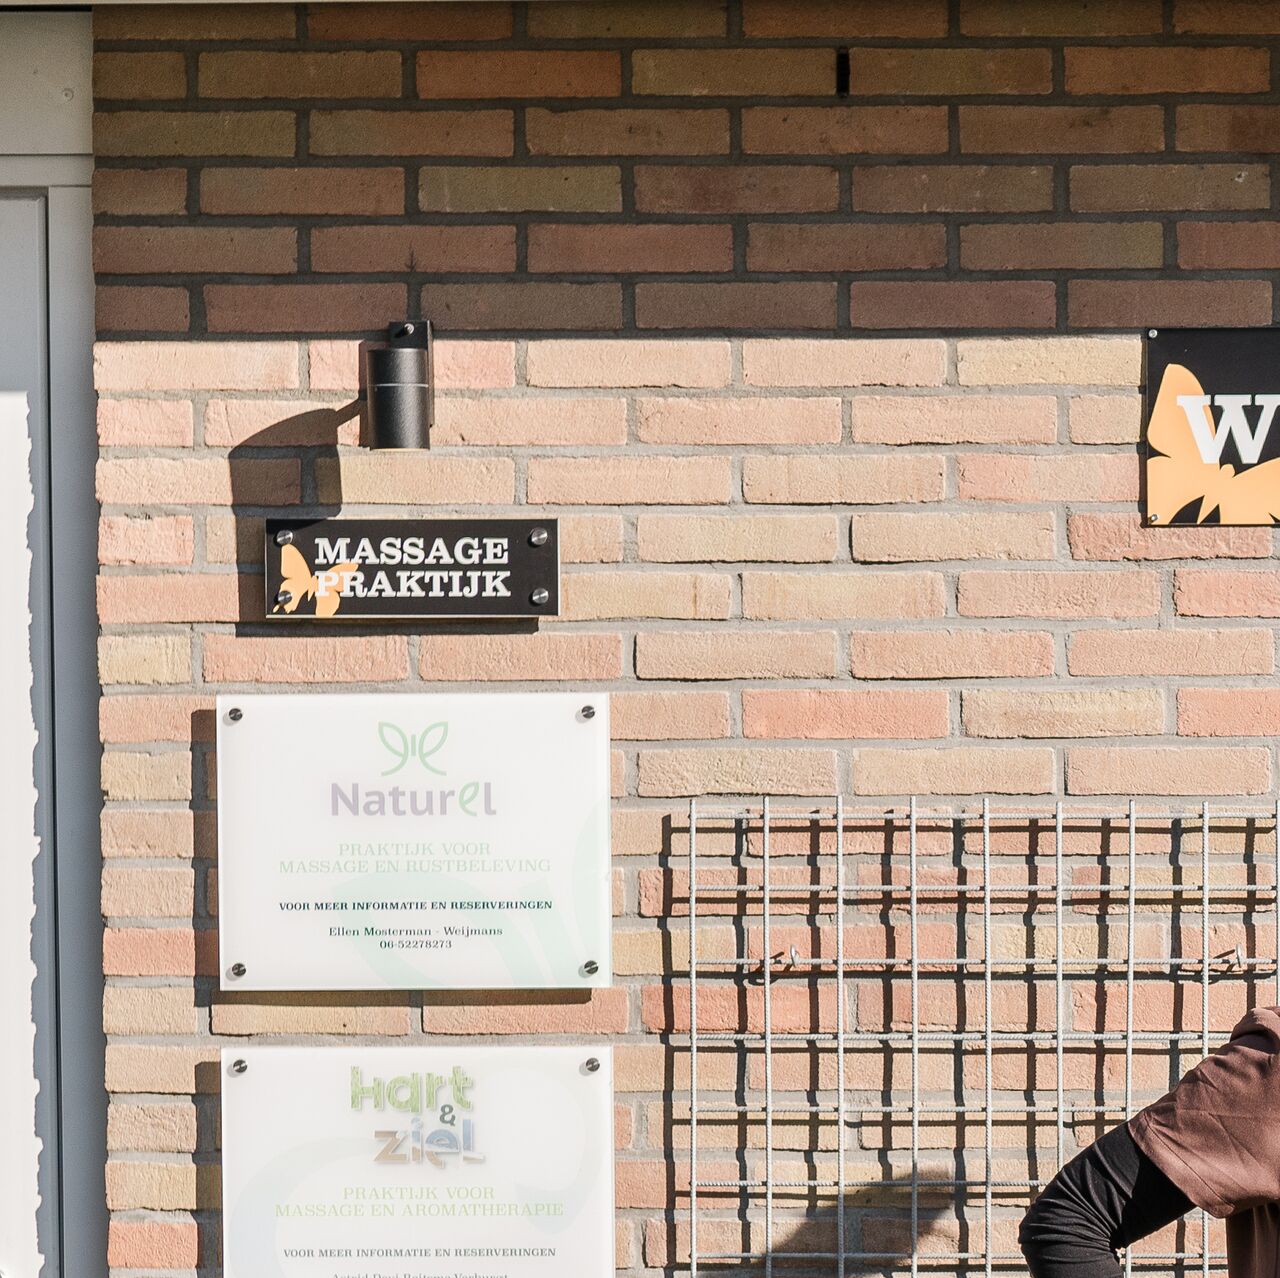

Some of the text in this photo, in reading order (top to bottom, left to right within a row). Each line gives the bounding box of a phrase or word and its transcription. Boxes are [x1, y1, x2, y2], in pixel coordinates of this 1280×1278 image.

[314, 537, 510, 565] MASSAGE
[314, 570, 512, 598] PRAKTIJK
[330, 781, 497, 817] Naturel
[338, 842, 491, 858] PRAKTIJK VOOR
[279, 858, 551, 874] MASSAGE EN RUSTBELEVING
[279, 900, 553, 911] VOOR MEER INFORMATIE EN RESERVERINGEN
[329, 926, 360, 937] Ellen
[364, 926, 432, 937] Mosterman
[443, 926, 503, 939] Weijmans
[439, 1103, 456, 1127] &
[343, 1186, 495, 1201] PRAKTIJK VOOR
[275, 1202, 564, 1217] MASSAGE EN AROMATHERAPIE
[283, 1247, 556, 1258] VOOR MEER INFORMATIE EN RESERVERINGEN
